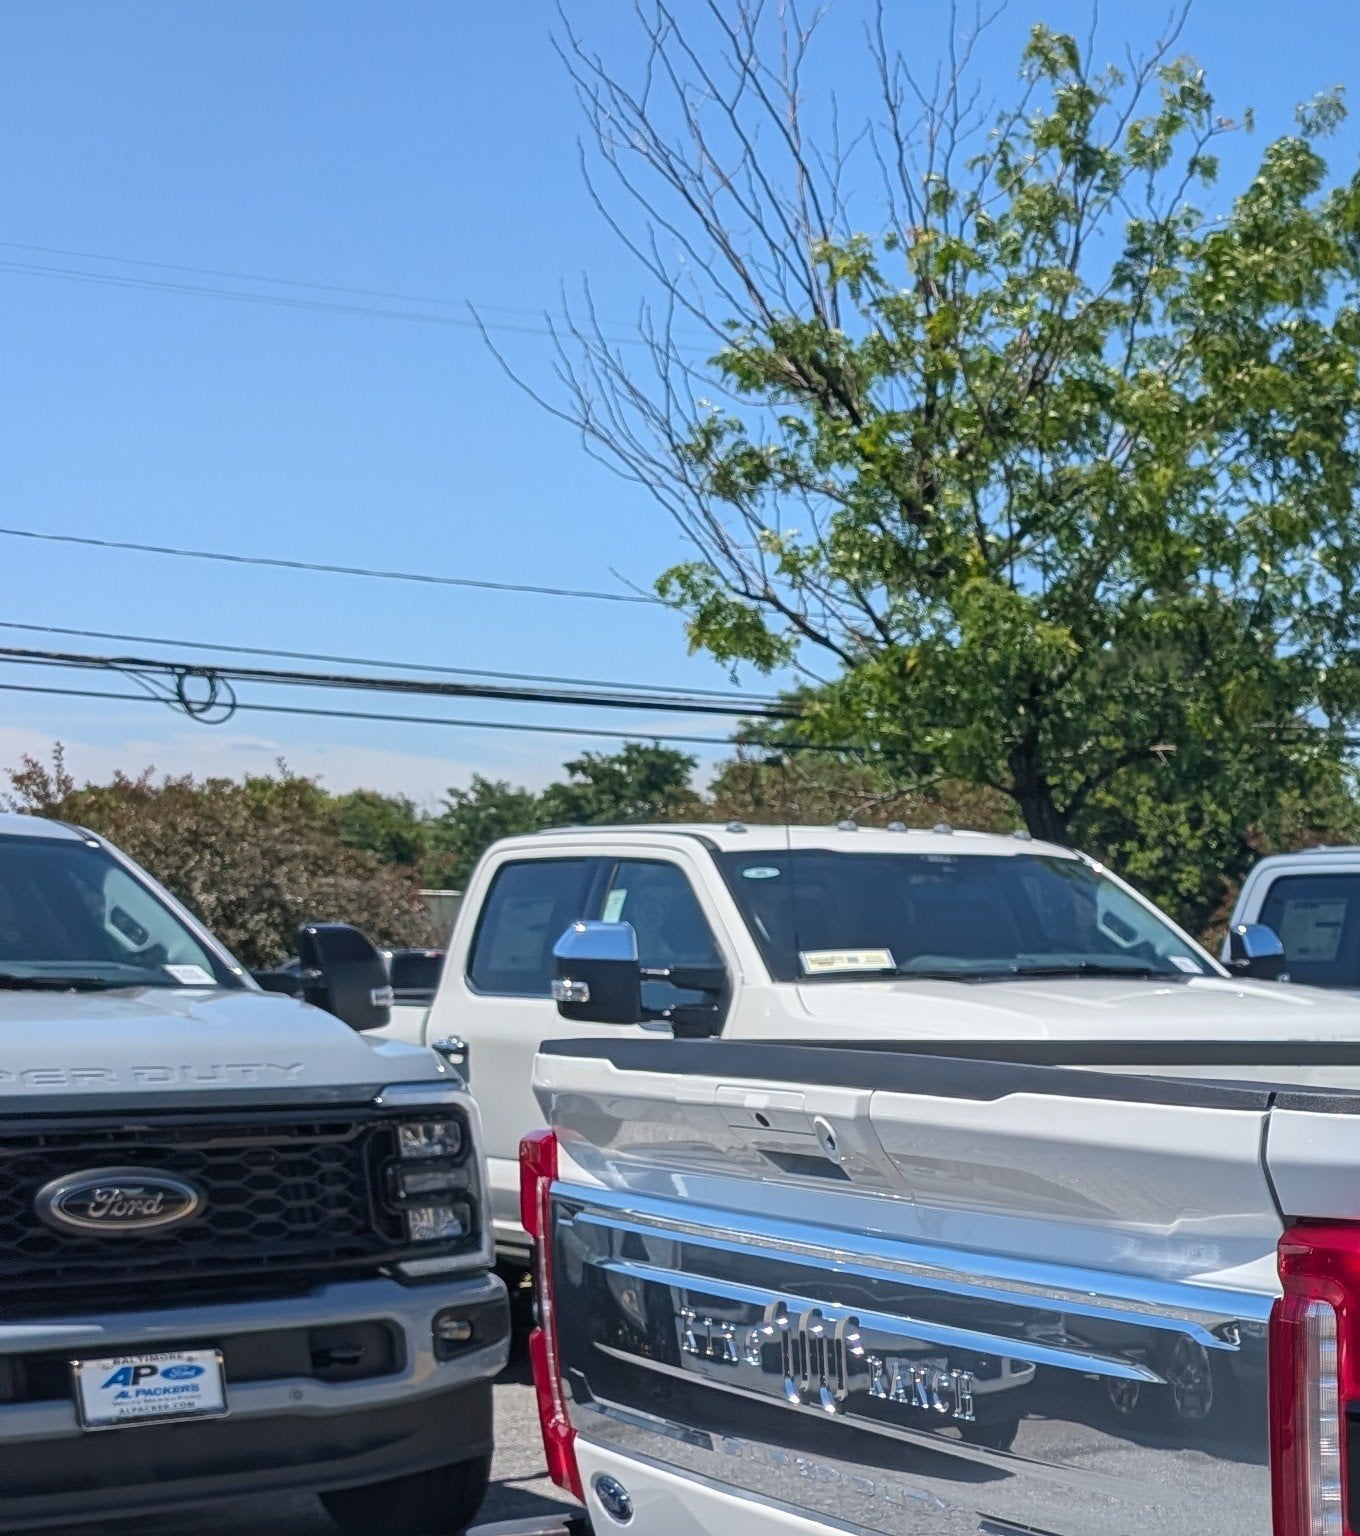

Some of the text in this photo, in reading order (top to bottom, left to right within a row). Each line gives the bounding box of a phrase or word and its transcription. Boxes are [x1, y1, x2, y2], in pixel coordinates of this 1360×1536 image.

[131, 1062, 303, 1085] DUTY
[88, 1187, 165, 1219] Ford
[101, 1364, 159, 1390] AP
[865, 1355, 977, 1422] RANCH
